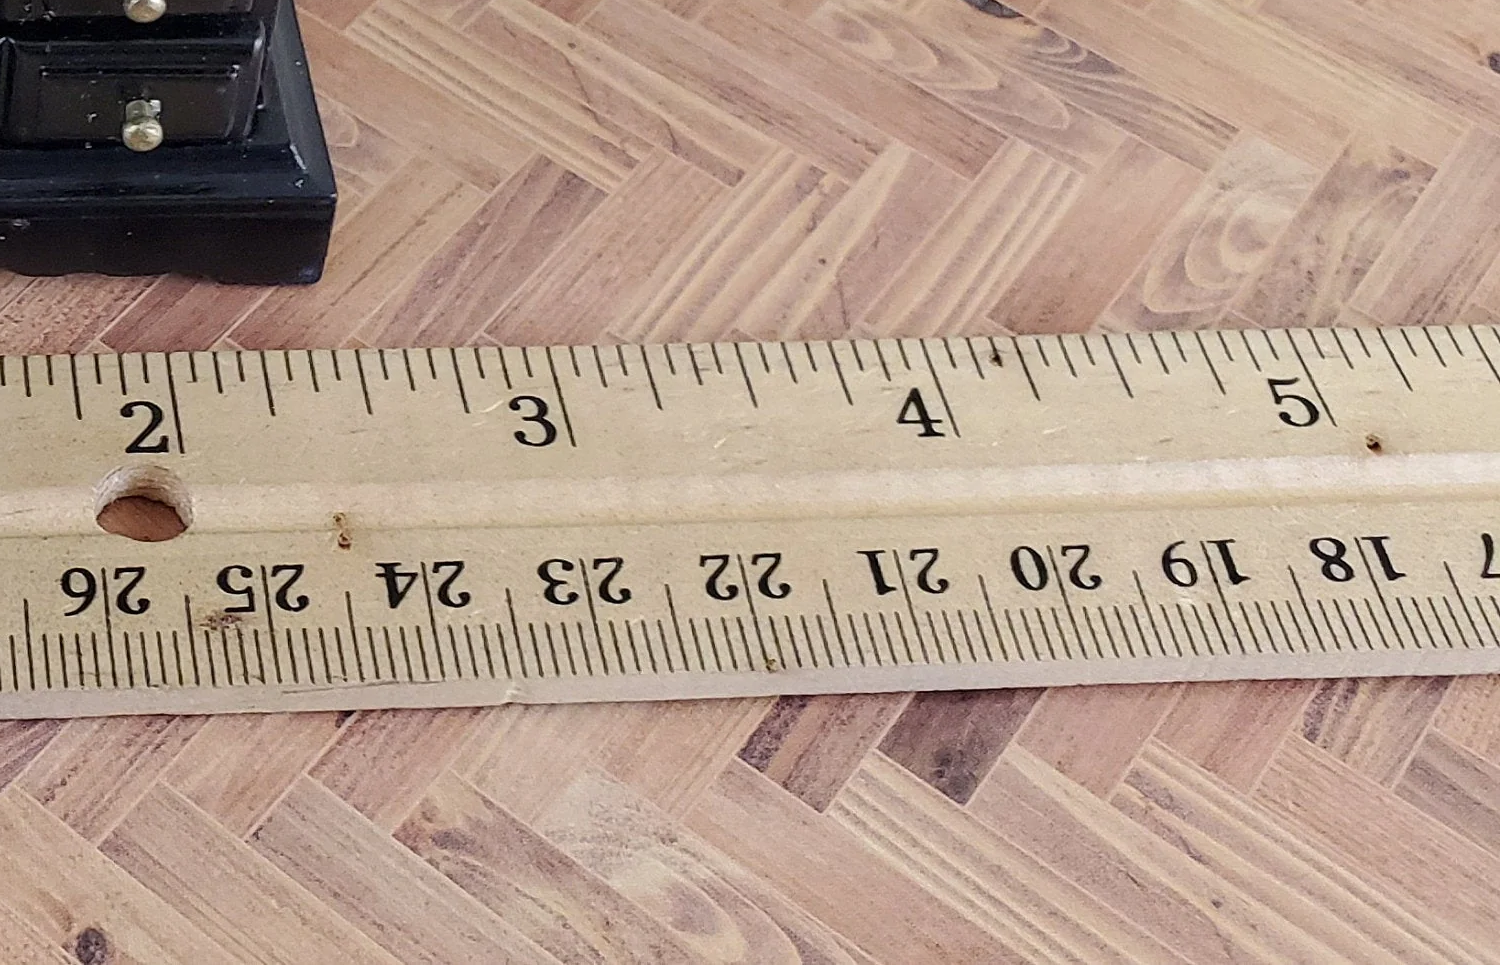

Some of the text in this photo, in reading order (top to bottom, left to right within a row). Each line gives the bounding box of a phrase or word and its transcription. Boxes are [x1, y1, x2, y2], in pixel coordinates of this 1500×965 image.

[120, 400, 170, 455] 2
[507, 395, 558, 447] 3
[896, 387, 945, 438] 4
[1266, 377, 1321, 428] 5
[536, 556, 632, 606] 23
[699, 552, 792, 601] 22
[856, 548, 950, 595] 21
[1010, 544, 1102, 593] 20
[1160, 538, 1252, 588] 19
[1308, 535, 1406, 583] 18
[60, 566, 151, 617] 26
[215, 564, 310, 614] 25
[375, 560, 472, 610] 24
